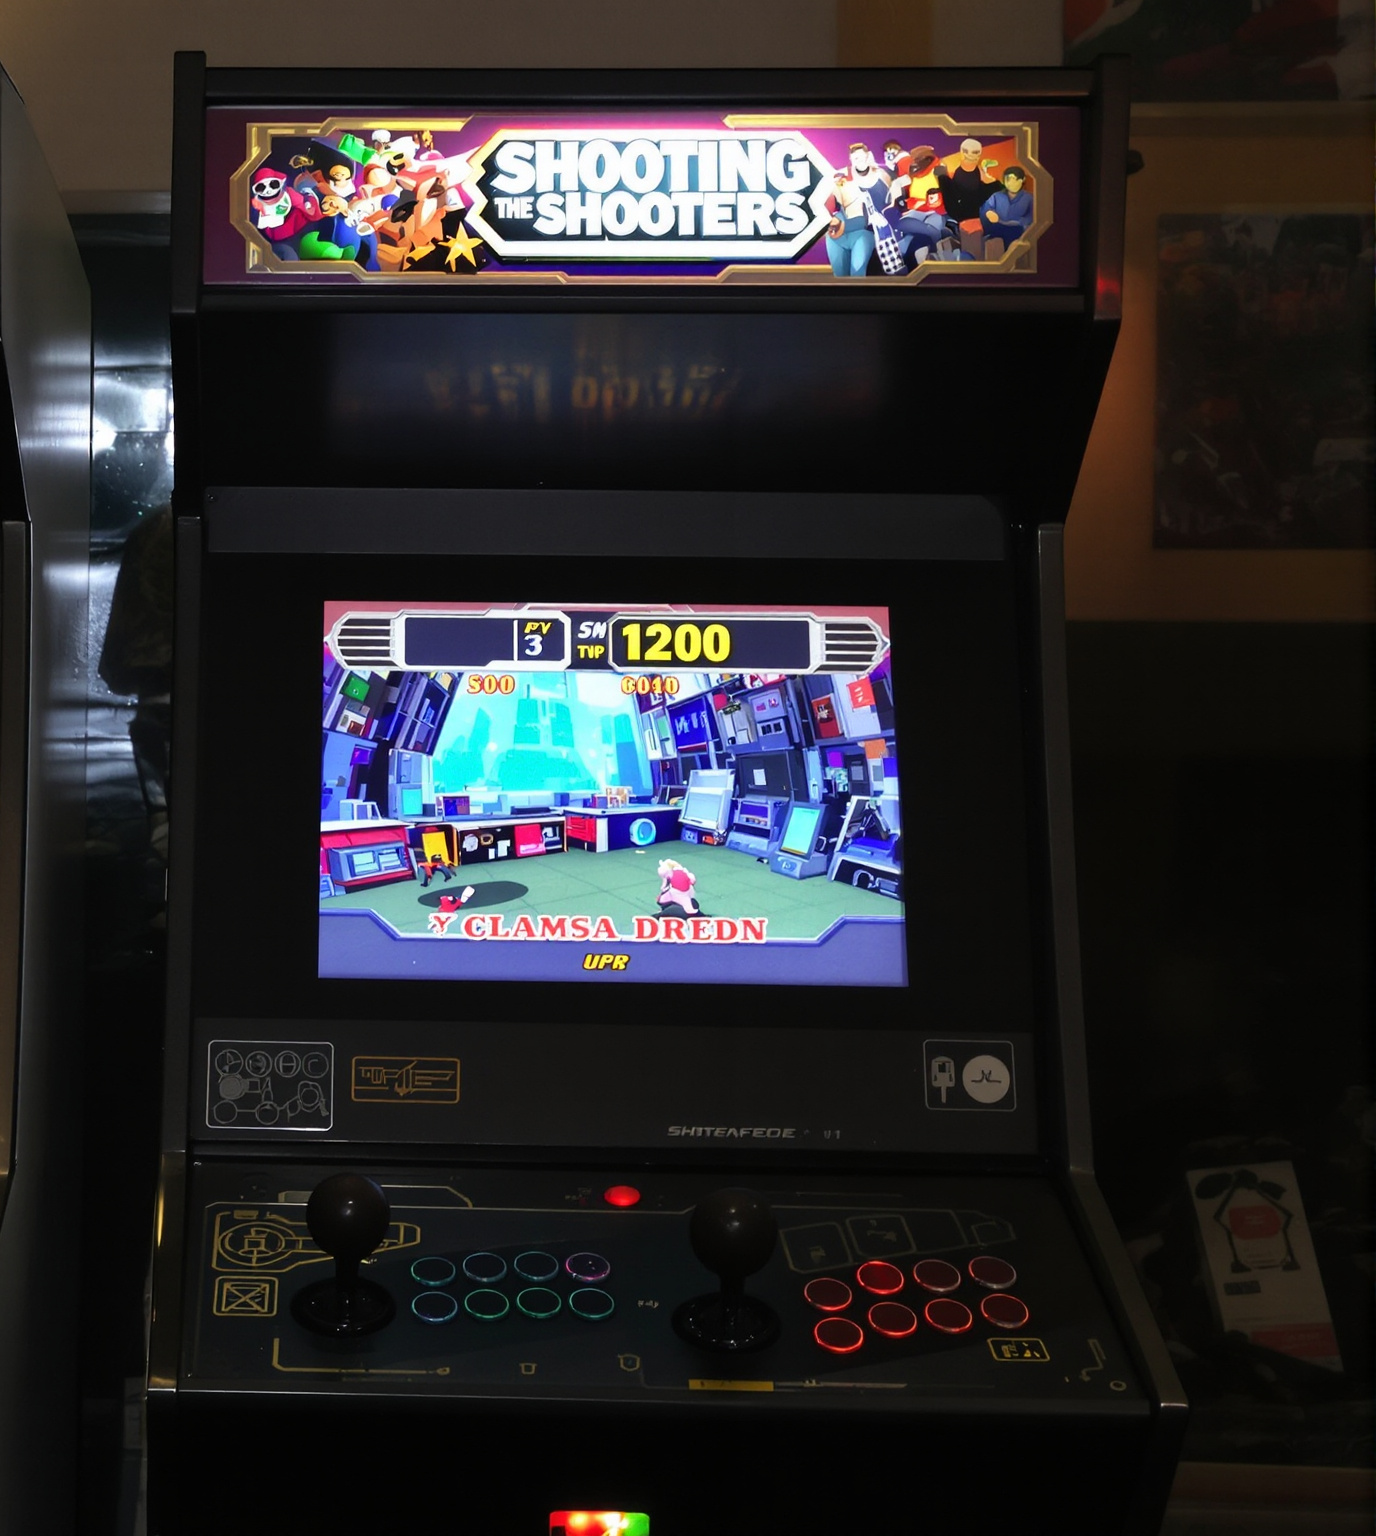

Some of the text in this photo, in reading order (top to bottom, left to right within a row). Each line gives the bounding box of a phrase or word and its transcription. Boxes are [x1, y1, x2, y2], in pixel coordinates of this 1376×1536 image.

[490, 138, 811, 194] SHOOTING
[494, 191, 810, 236] THE SHOOTERS
[524, 634, 543, 656] 3
[622, 622, 731, 662] 1200
[464, 915, 620, 939] CLAMSA
[634, 917, 766, 941] DREDN
[582, 953, 630, 970] UPR
